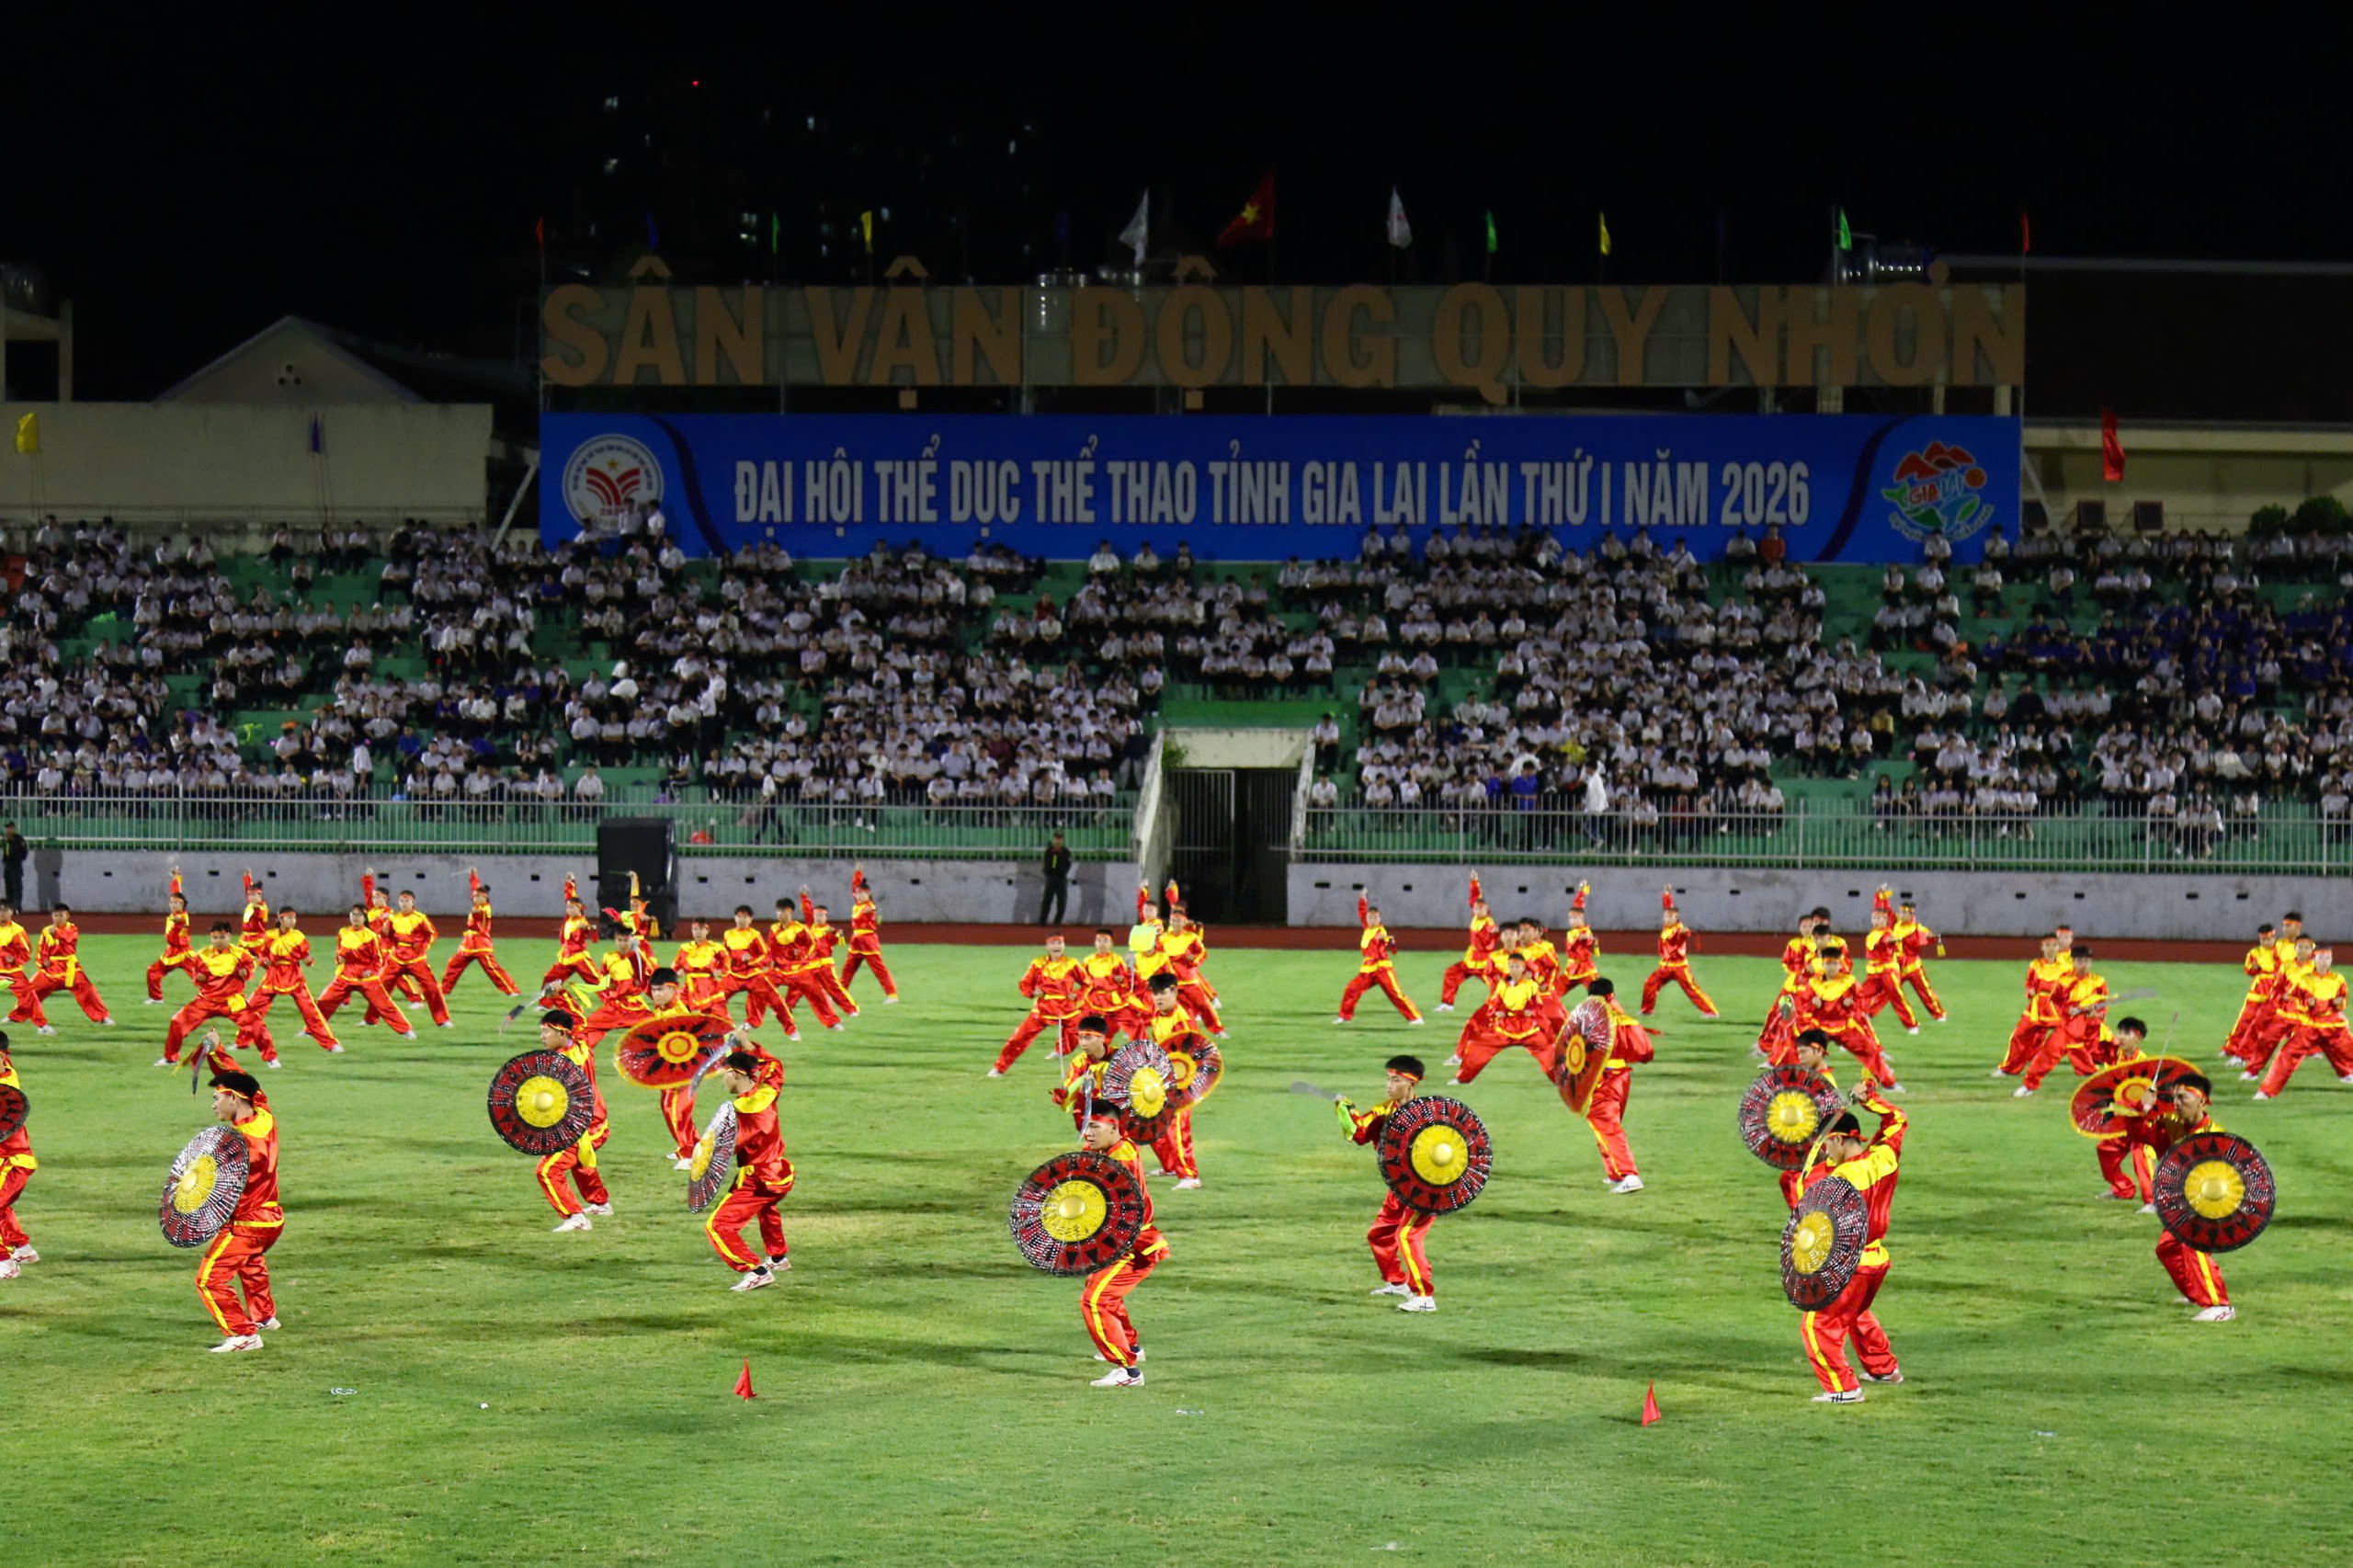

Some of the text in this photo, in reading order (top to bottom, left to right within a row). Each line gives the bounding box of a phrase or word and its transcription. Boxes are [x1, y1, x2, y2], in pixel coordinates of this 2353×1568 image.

[540, 256, 2024, 409] SÂN VẬN ĐỘNG QUY NHƠN
[735, 460, 793, 538] ĐẠI
[805, 447, 863, 538] HỘI
[874, 434, 941, 523] THỂ
[950, 460, 1020, 538] DỤC
[1032, 434, 1099, 523] THỂ
[1107, 460, 1197, 524] THAO
[1209, 439, 1289, 524] TỈNH
[1302, 460, 1362, 525] GIA
[1375, 460, 1427, 525] LAI
[1439, 438, 1509, 526] LẦN
[1521, 448, 1594, 526] THỨ
[1601, 462, 1612, 526] I
[1625, 449, 1710, 526] NĂM
[1722, 462, 1810, 526] 2026
[1909, 483, 1938, 505] GIA
